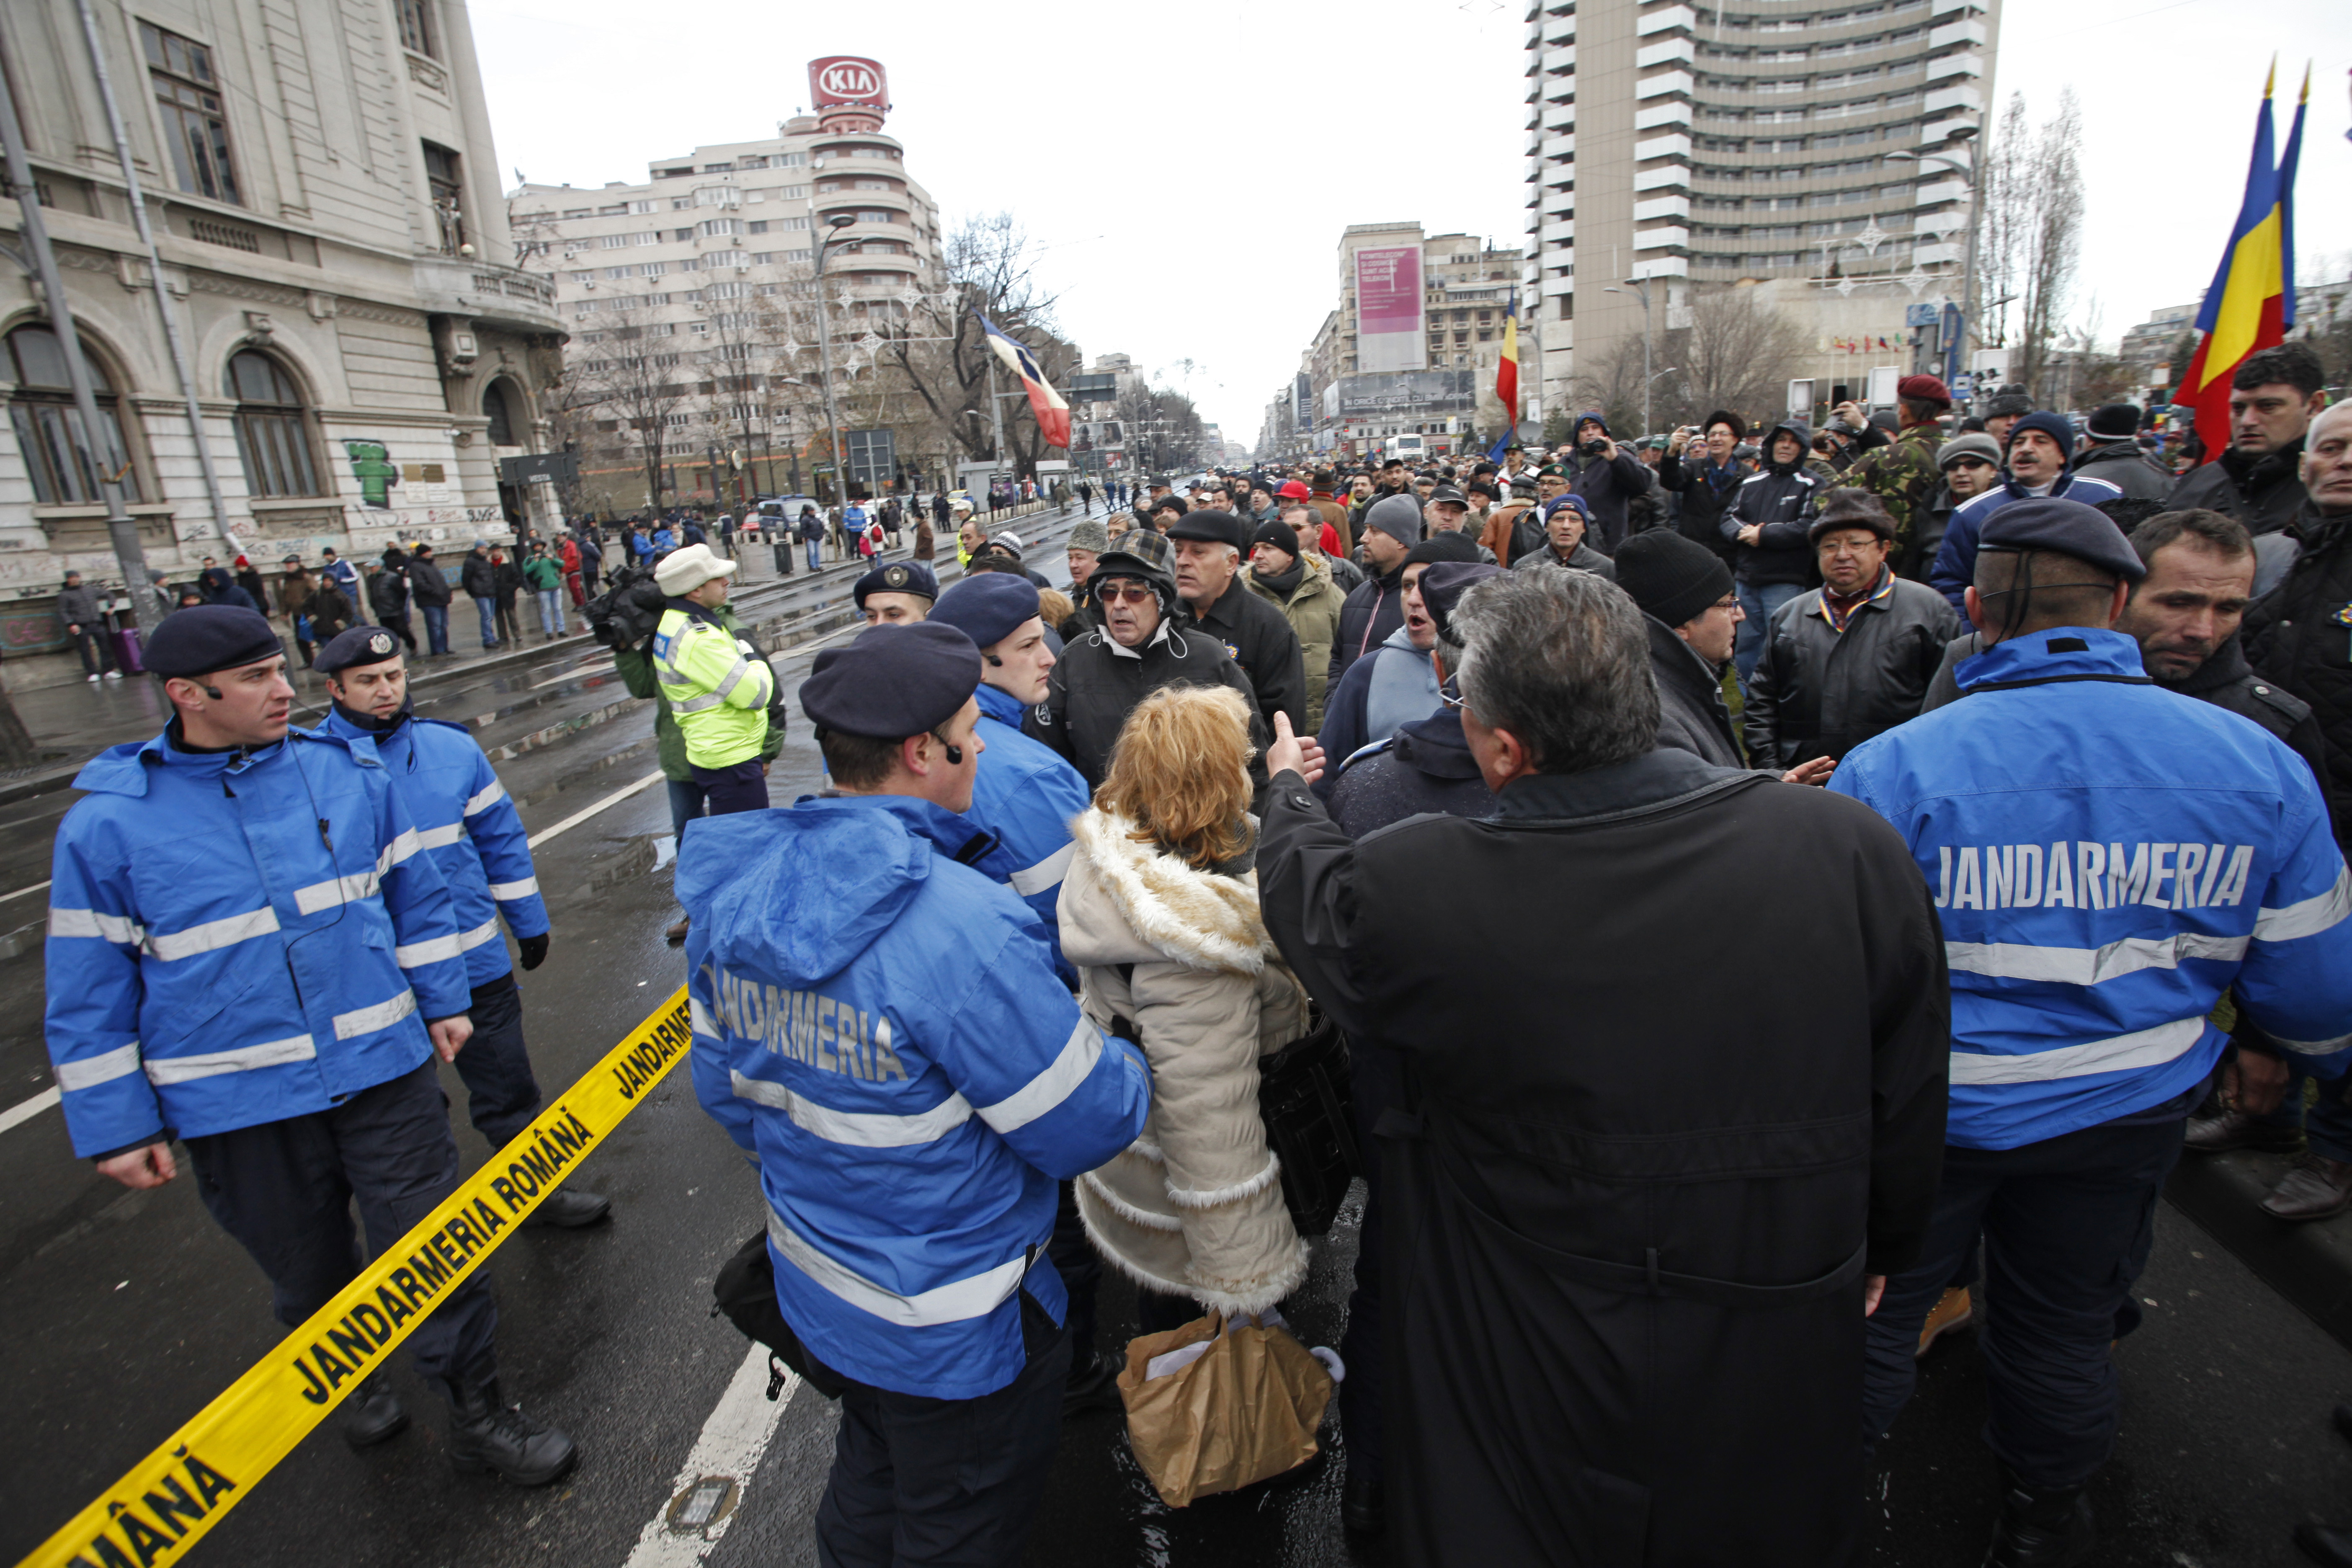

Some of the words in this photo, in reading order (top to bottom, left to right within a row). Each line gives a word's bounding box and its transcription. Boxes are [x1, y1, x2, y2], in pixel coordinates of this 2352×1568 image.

[829, 69, 874, 92] KIA
[1934, 841, 2254, 910] JANDARMERIA
[293, 1196, 509, 1405] JANDARMERIA
[490, 1104, 595, 1215] ROMÂNĂ
